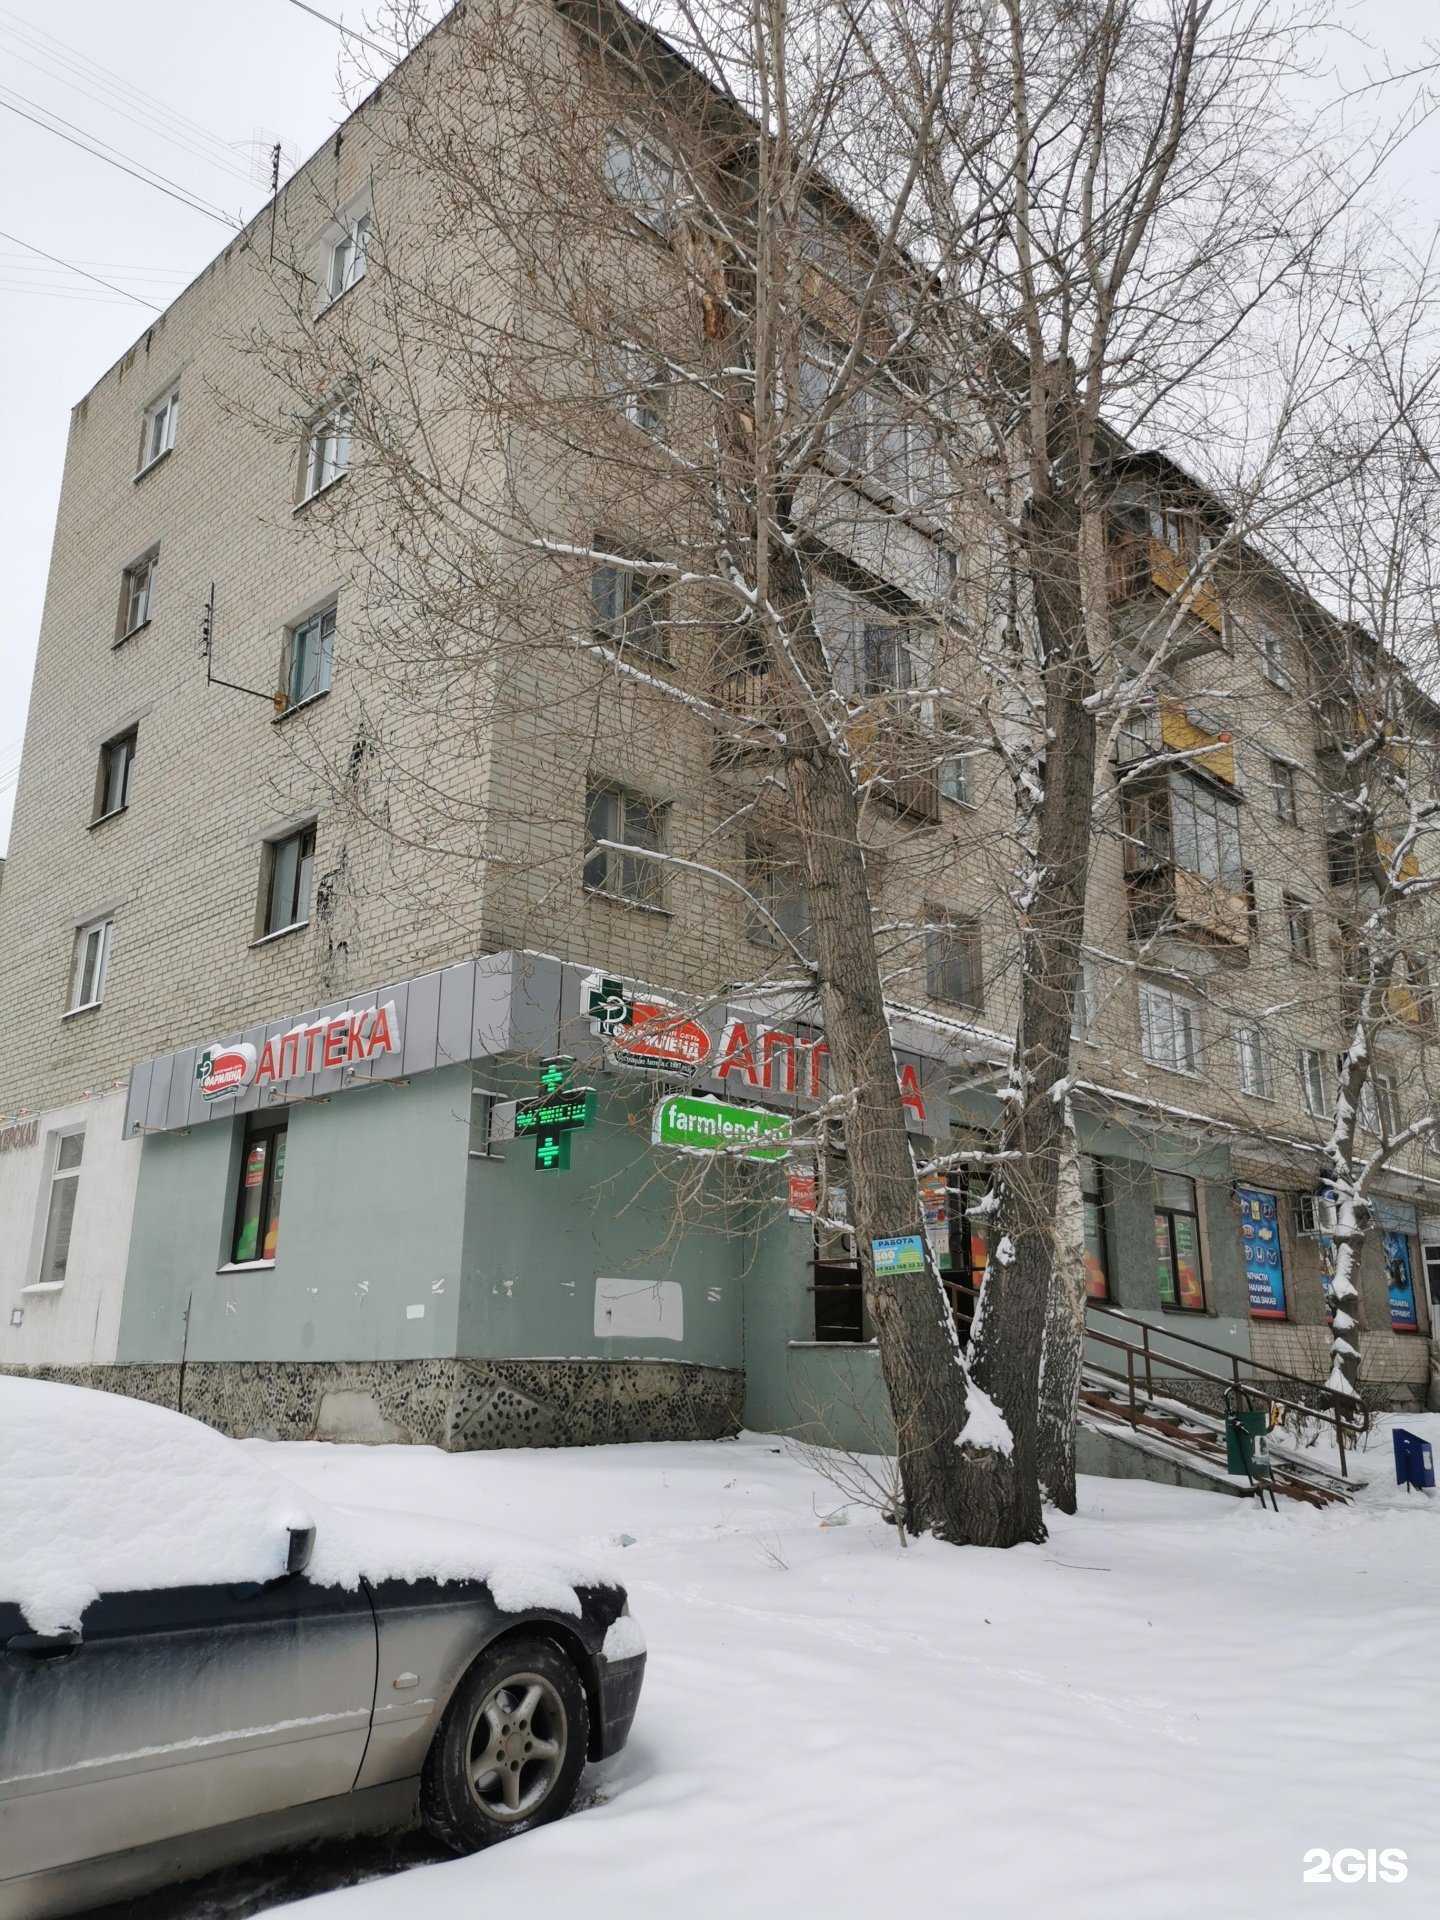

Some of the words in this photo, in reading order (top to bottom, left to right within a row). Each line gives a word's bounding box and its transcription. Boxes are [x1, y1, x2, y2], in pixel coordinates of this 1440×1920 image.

[256, 1008, 392, 1085] АПТЕКА
[719, 1022, 926, 1120] АПТА
[878, 1238, 914, 1247] РАБОТА
